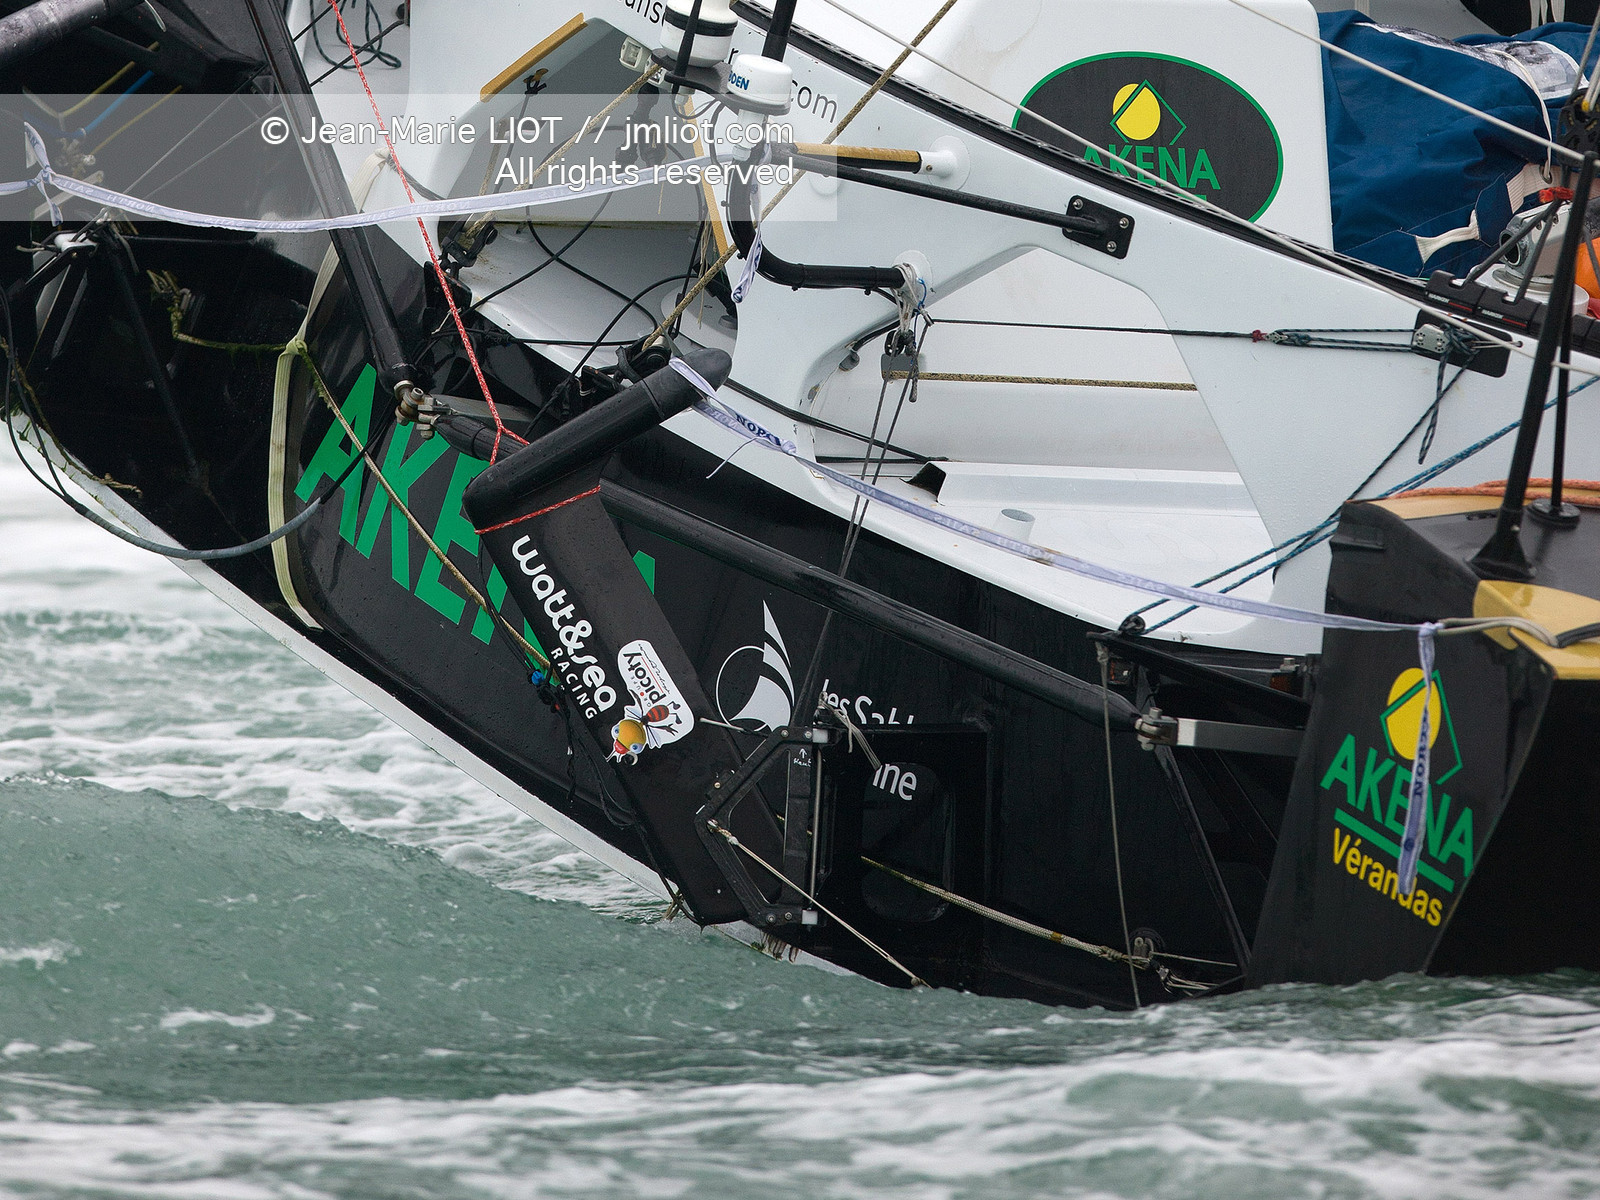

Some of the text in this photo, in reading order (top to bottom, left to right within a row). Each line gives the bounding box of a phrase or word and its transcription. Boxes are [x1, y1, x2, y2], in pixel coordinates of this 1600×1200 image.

[511, 534, 617, 713] watt&sea
[622, 652, 667, 704] picoty
[551, 647, 598, 720] RACING
[1319, 732, 1474, 878] AKENA
